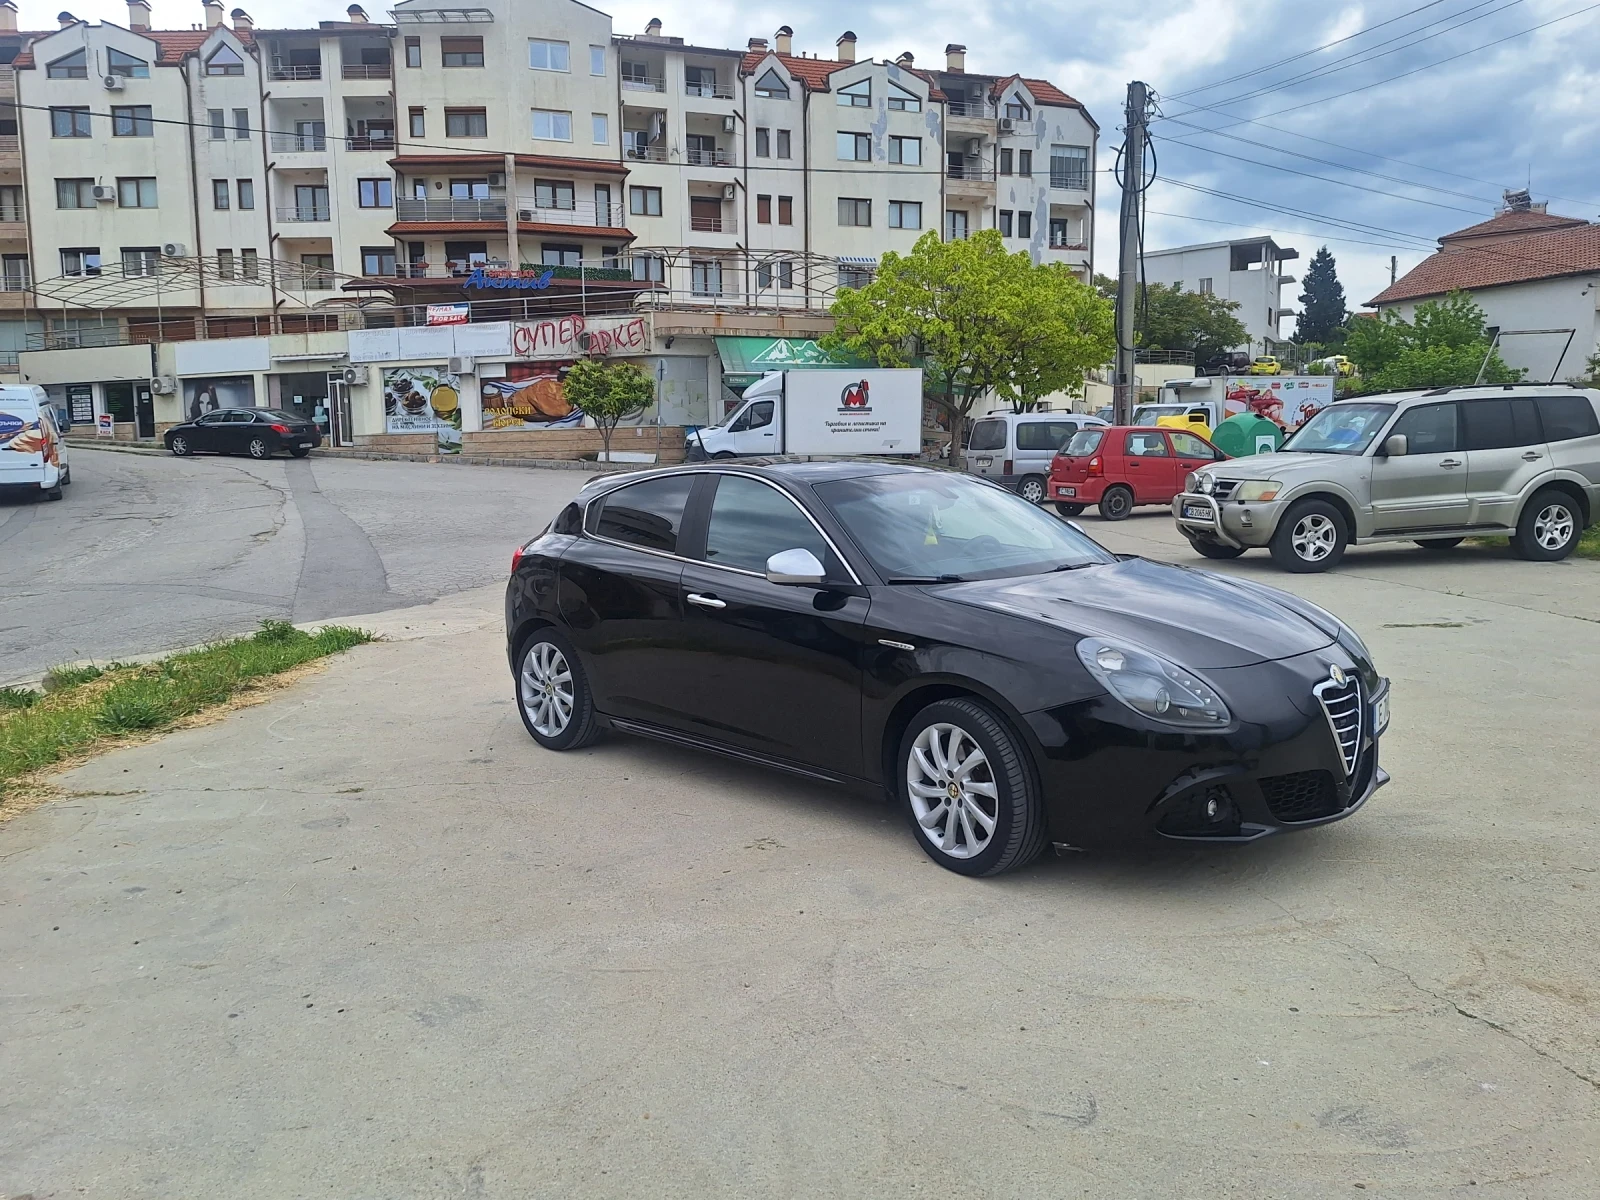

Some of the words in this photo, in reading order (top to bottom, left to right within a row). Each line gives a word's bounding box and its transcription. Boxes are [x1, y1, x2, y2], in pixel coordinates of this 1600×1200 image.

[463, 268, 553, 290] Актив
[513, 314, 585, 354] СУПЕР
[484, 406, 531, 416] РОДОПСКИ
